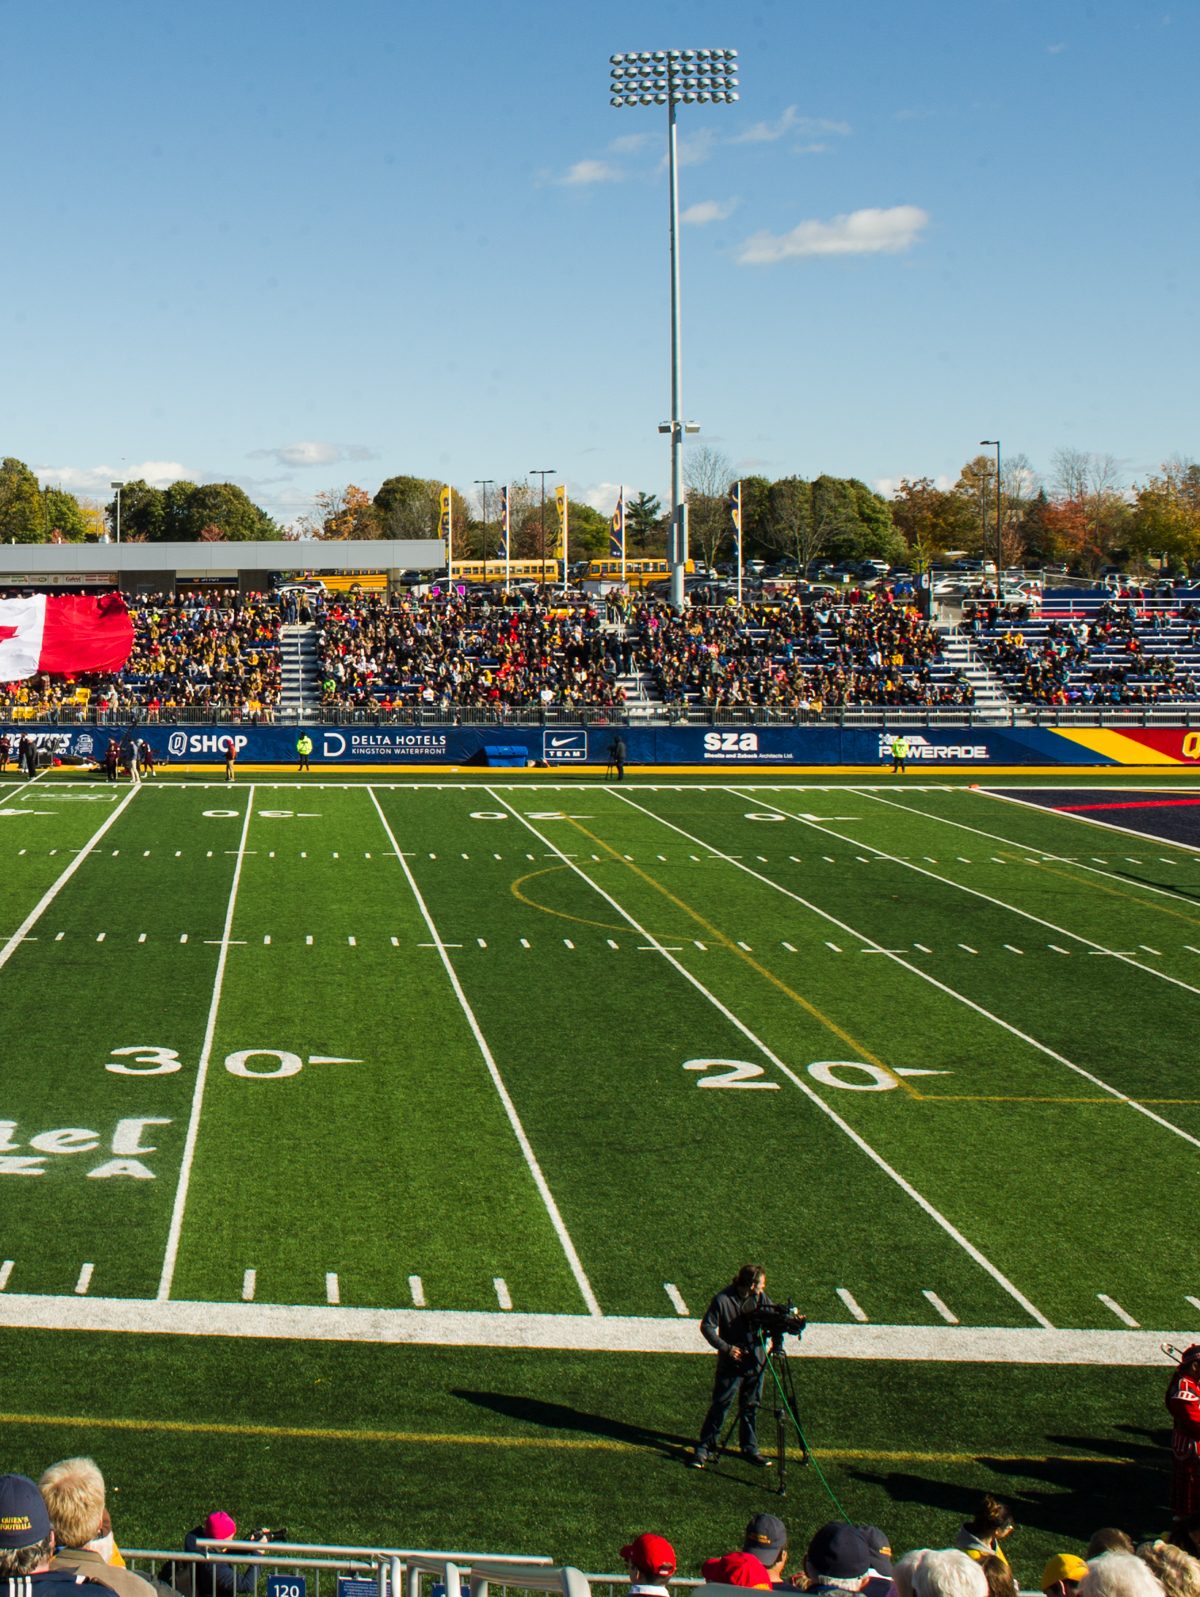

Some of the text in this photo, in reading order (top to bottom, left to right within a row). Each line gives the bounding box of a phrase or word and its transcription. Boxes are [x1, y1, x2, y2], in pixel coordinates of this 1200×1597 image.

[189, 735, 248, 752] SHOP
[351, 735, 447, 745] DELTA HOTELS
[703, 732, 758, 751] sza
[879, 746, 987, 758] PWERADE
[105, 1046, 303, 1078] 30
[682, 1059, 899, 1091] 20
[274, 1584, 300, 1597] 120
